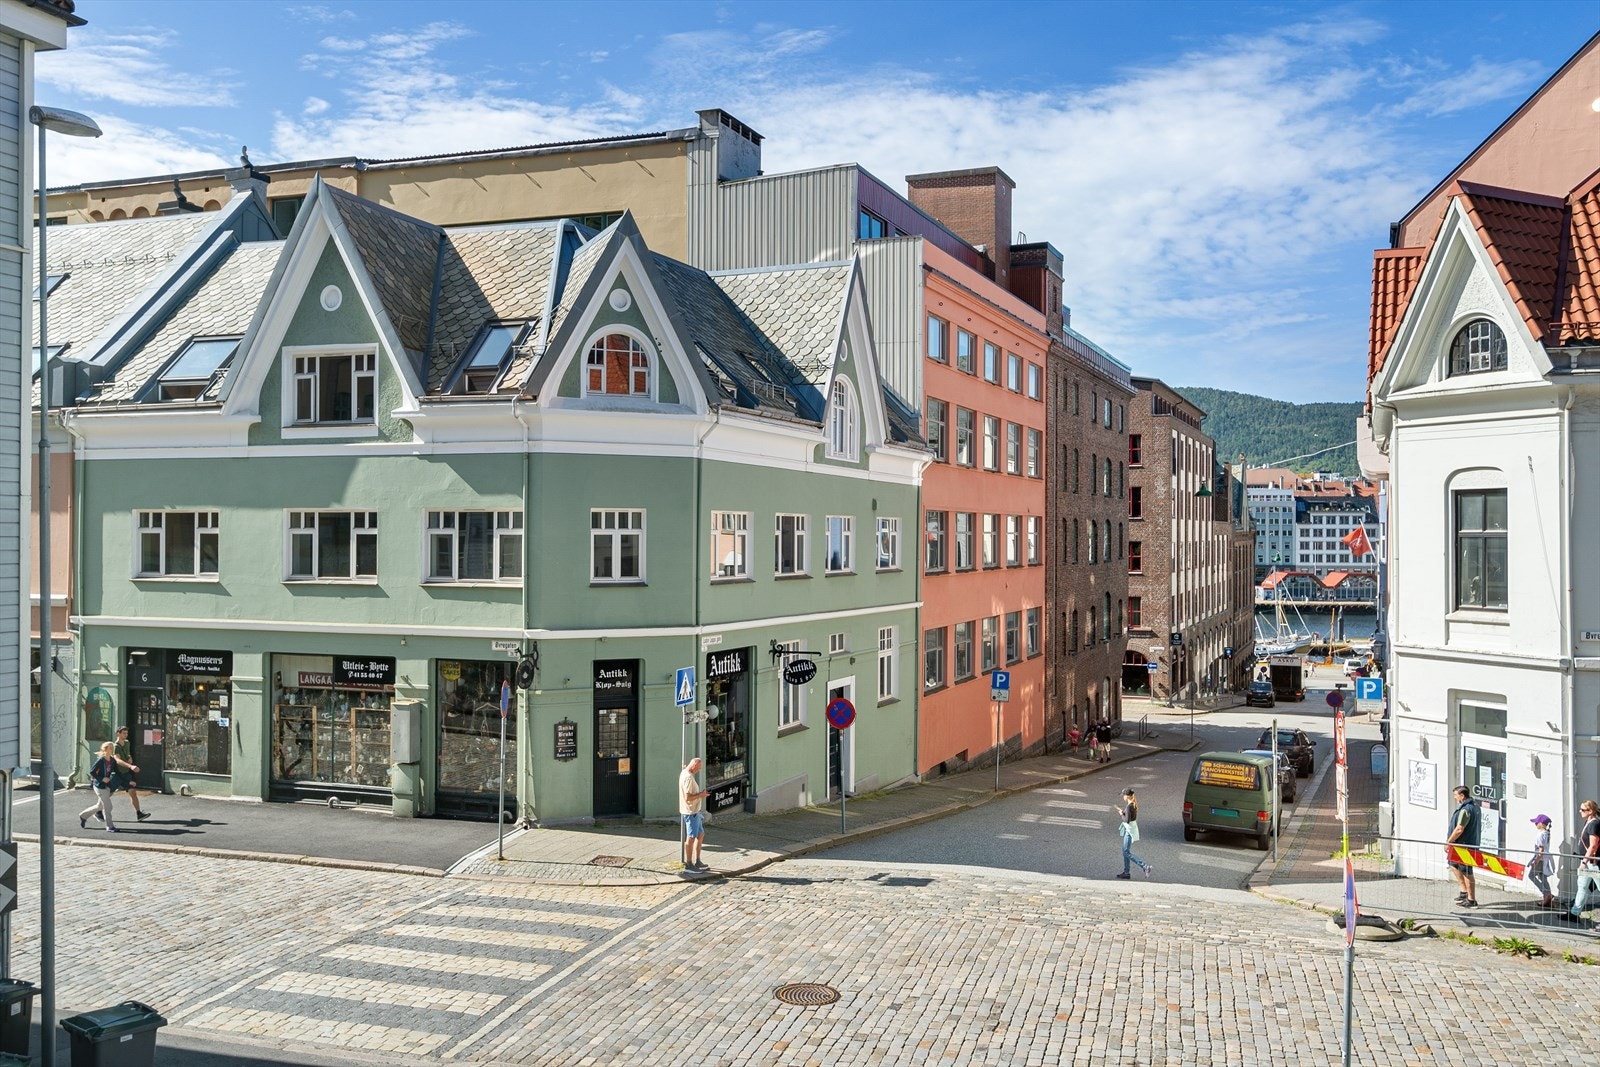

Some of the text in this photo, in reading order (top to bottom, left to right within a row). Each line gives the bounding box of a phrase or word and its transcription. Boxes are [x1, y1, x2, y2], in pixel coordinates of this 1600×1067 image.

[495, 641, 517, 650] Øvregaten
[709, 652, 741, 676] Antikk
[786, 661, 814, 674] Antikk
[141, 672, 148, 682] 6
[598, 669, 628, 679] Antikk
[996, 673, 1006, 688] P
[1363, 680, 1377, 699] P
[1201, 766, 1244, 776] PIANOVERKSTED
[1213, 763, 1244, 771] SCHUMANN
[1472, 784, 1497, 799] GITZI
